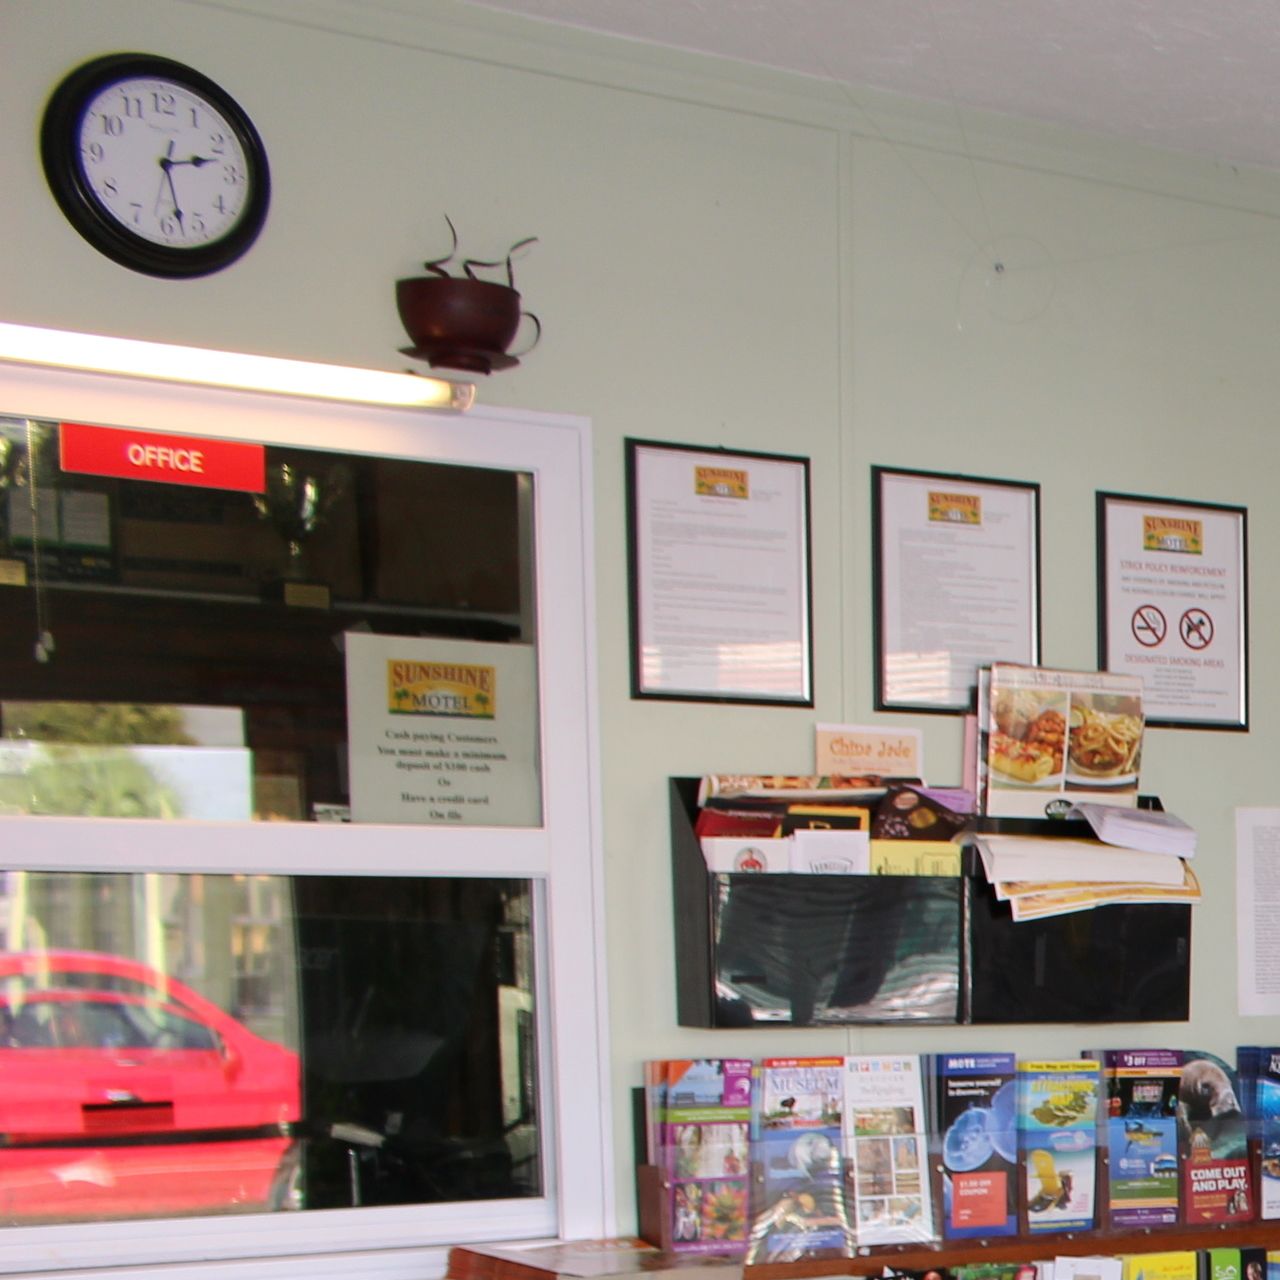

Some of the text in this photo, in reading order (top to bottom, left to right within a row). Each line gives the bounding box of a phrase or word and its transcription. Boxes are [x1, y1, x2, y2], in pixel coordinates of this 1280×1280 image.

[124, 96, 143, 119] 11
[152, 93, 175, 116] 12
[103, 114, 123, 136] 10
[190, 108, 198, 129] 1
[90, 143, 103, 163] 9
[210, 134, 224, 154] 2
[224, 165, 237, 185] 3
[104, 177, 118, 198] 8
[130, 201, 142, 224] 7
[213, 194, 224, 215] 4
[160, 216, 174, 236] 6
[192, 211, 205, 232] 5
[128, 443, 204, 473] OFFICE
[1146, 519, 1198, 535] SUNSHINE
[393, 663, 490, 692] SUNSHINE
[412, 694, 472, 711] MOTEL
[385, 729, 409, 739] Cash
[830, 737, 911, 758] China Jade
[1191, 1166, 1246, 1180] COME OUT
[1192, 1178, 1248, 1193] AND PLAY.
